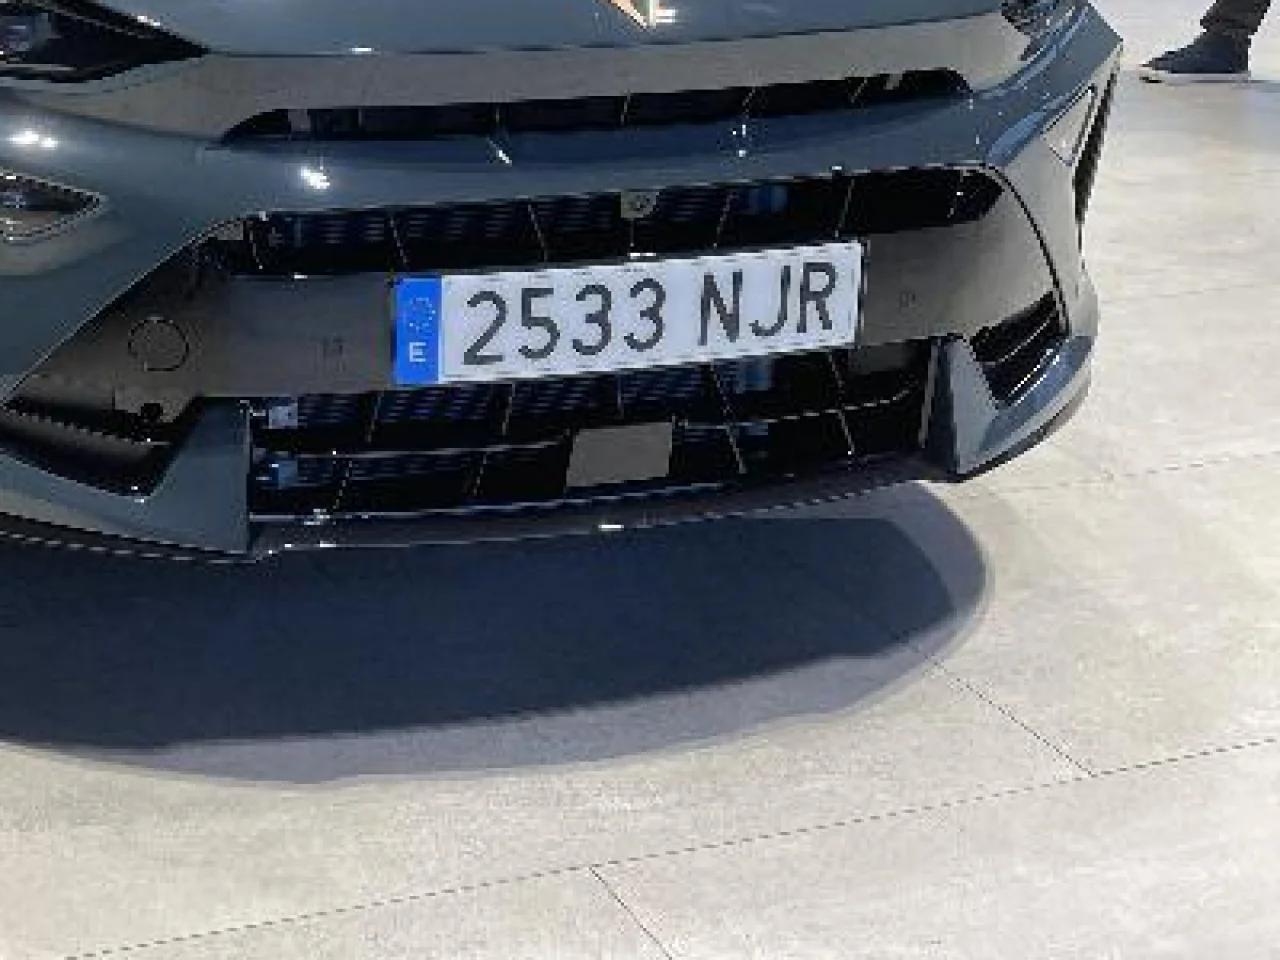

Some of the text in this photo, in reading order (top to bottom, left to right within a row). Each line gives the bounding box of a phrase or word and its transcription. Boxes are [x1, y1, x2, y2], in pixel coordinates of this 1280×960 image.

[463, 261, 837, 366] 2533 NJR
[408, 341, 427, 363] E
